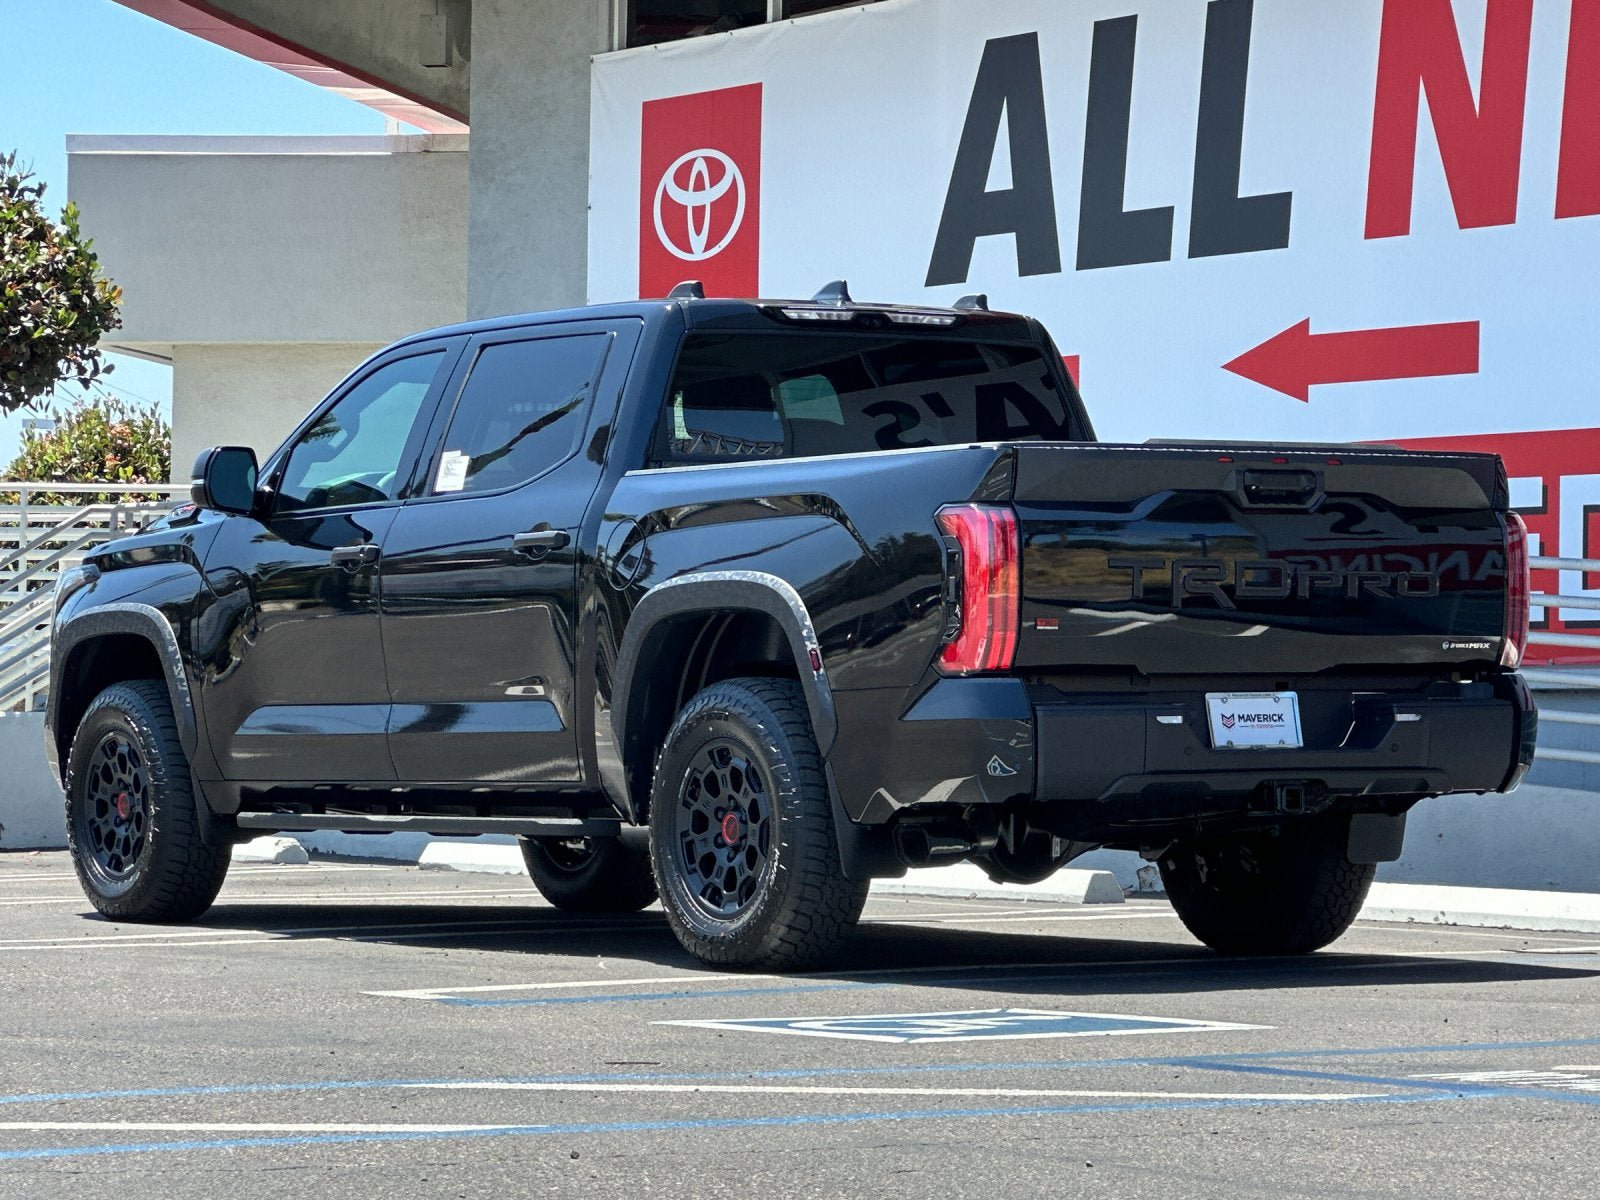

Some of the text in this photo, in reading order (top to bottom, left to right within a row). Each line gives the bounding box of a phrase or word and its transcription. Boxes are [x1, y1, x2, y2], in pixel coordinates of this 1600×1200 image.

[925, 0, 1600, 286] ALL N
[1107, 557, 1440, 610] TRD PRO
[1237, 713, 1285, 723] MAVERICK
